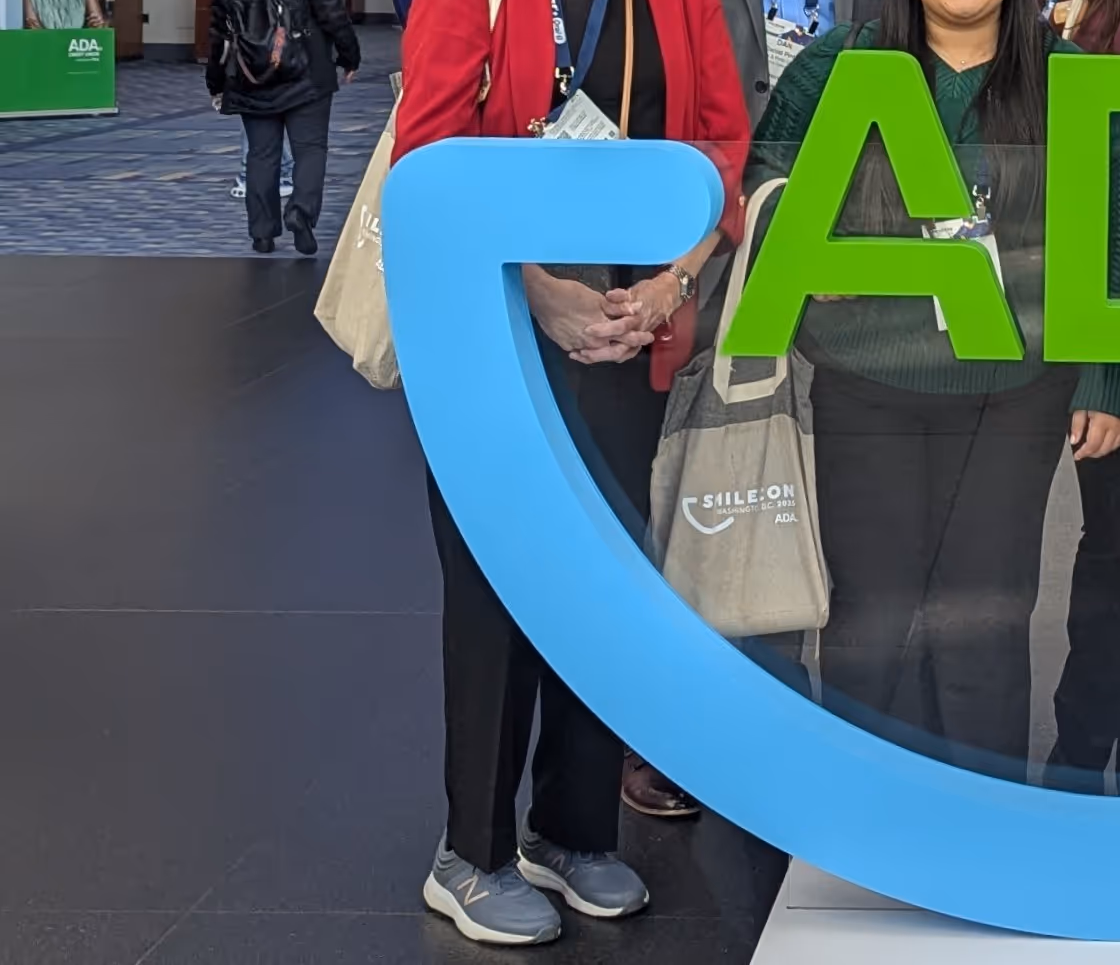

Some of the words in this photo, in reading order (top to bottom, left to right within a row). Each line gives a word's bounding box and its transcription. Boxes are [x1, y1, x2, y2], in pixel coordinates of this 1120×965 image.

[68, 39, 98, 52] ADA
[776, 39, 793, 49] DAN
[774, 513, 796, 524] ADA
